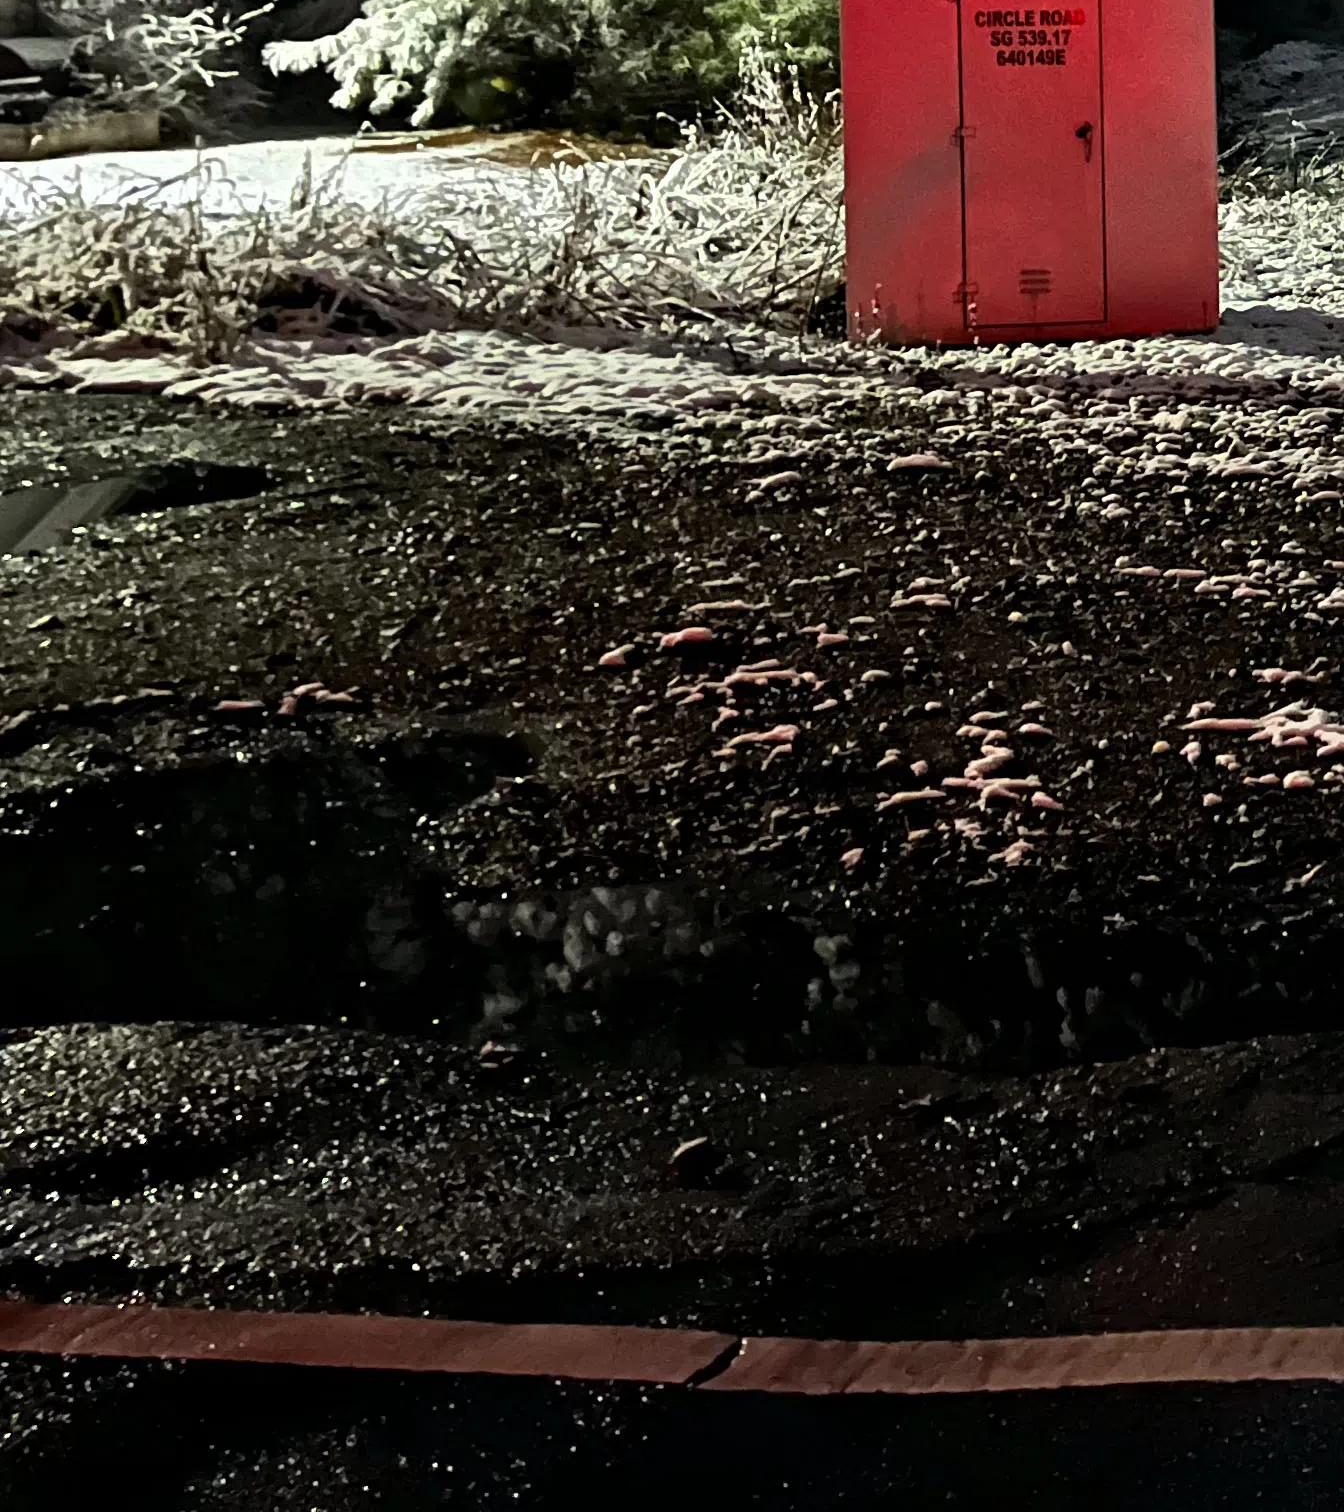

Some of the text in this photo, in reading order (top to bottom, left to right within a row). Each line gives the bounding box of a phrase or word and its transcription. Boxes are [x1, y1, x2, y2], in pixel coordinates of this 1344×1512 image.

[975, 9, 1085, 27] CIRCLE ROAD
[990, 29, 1072, 47] SG 539.17
[997, 49, 1066, 66] 640149E
